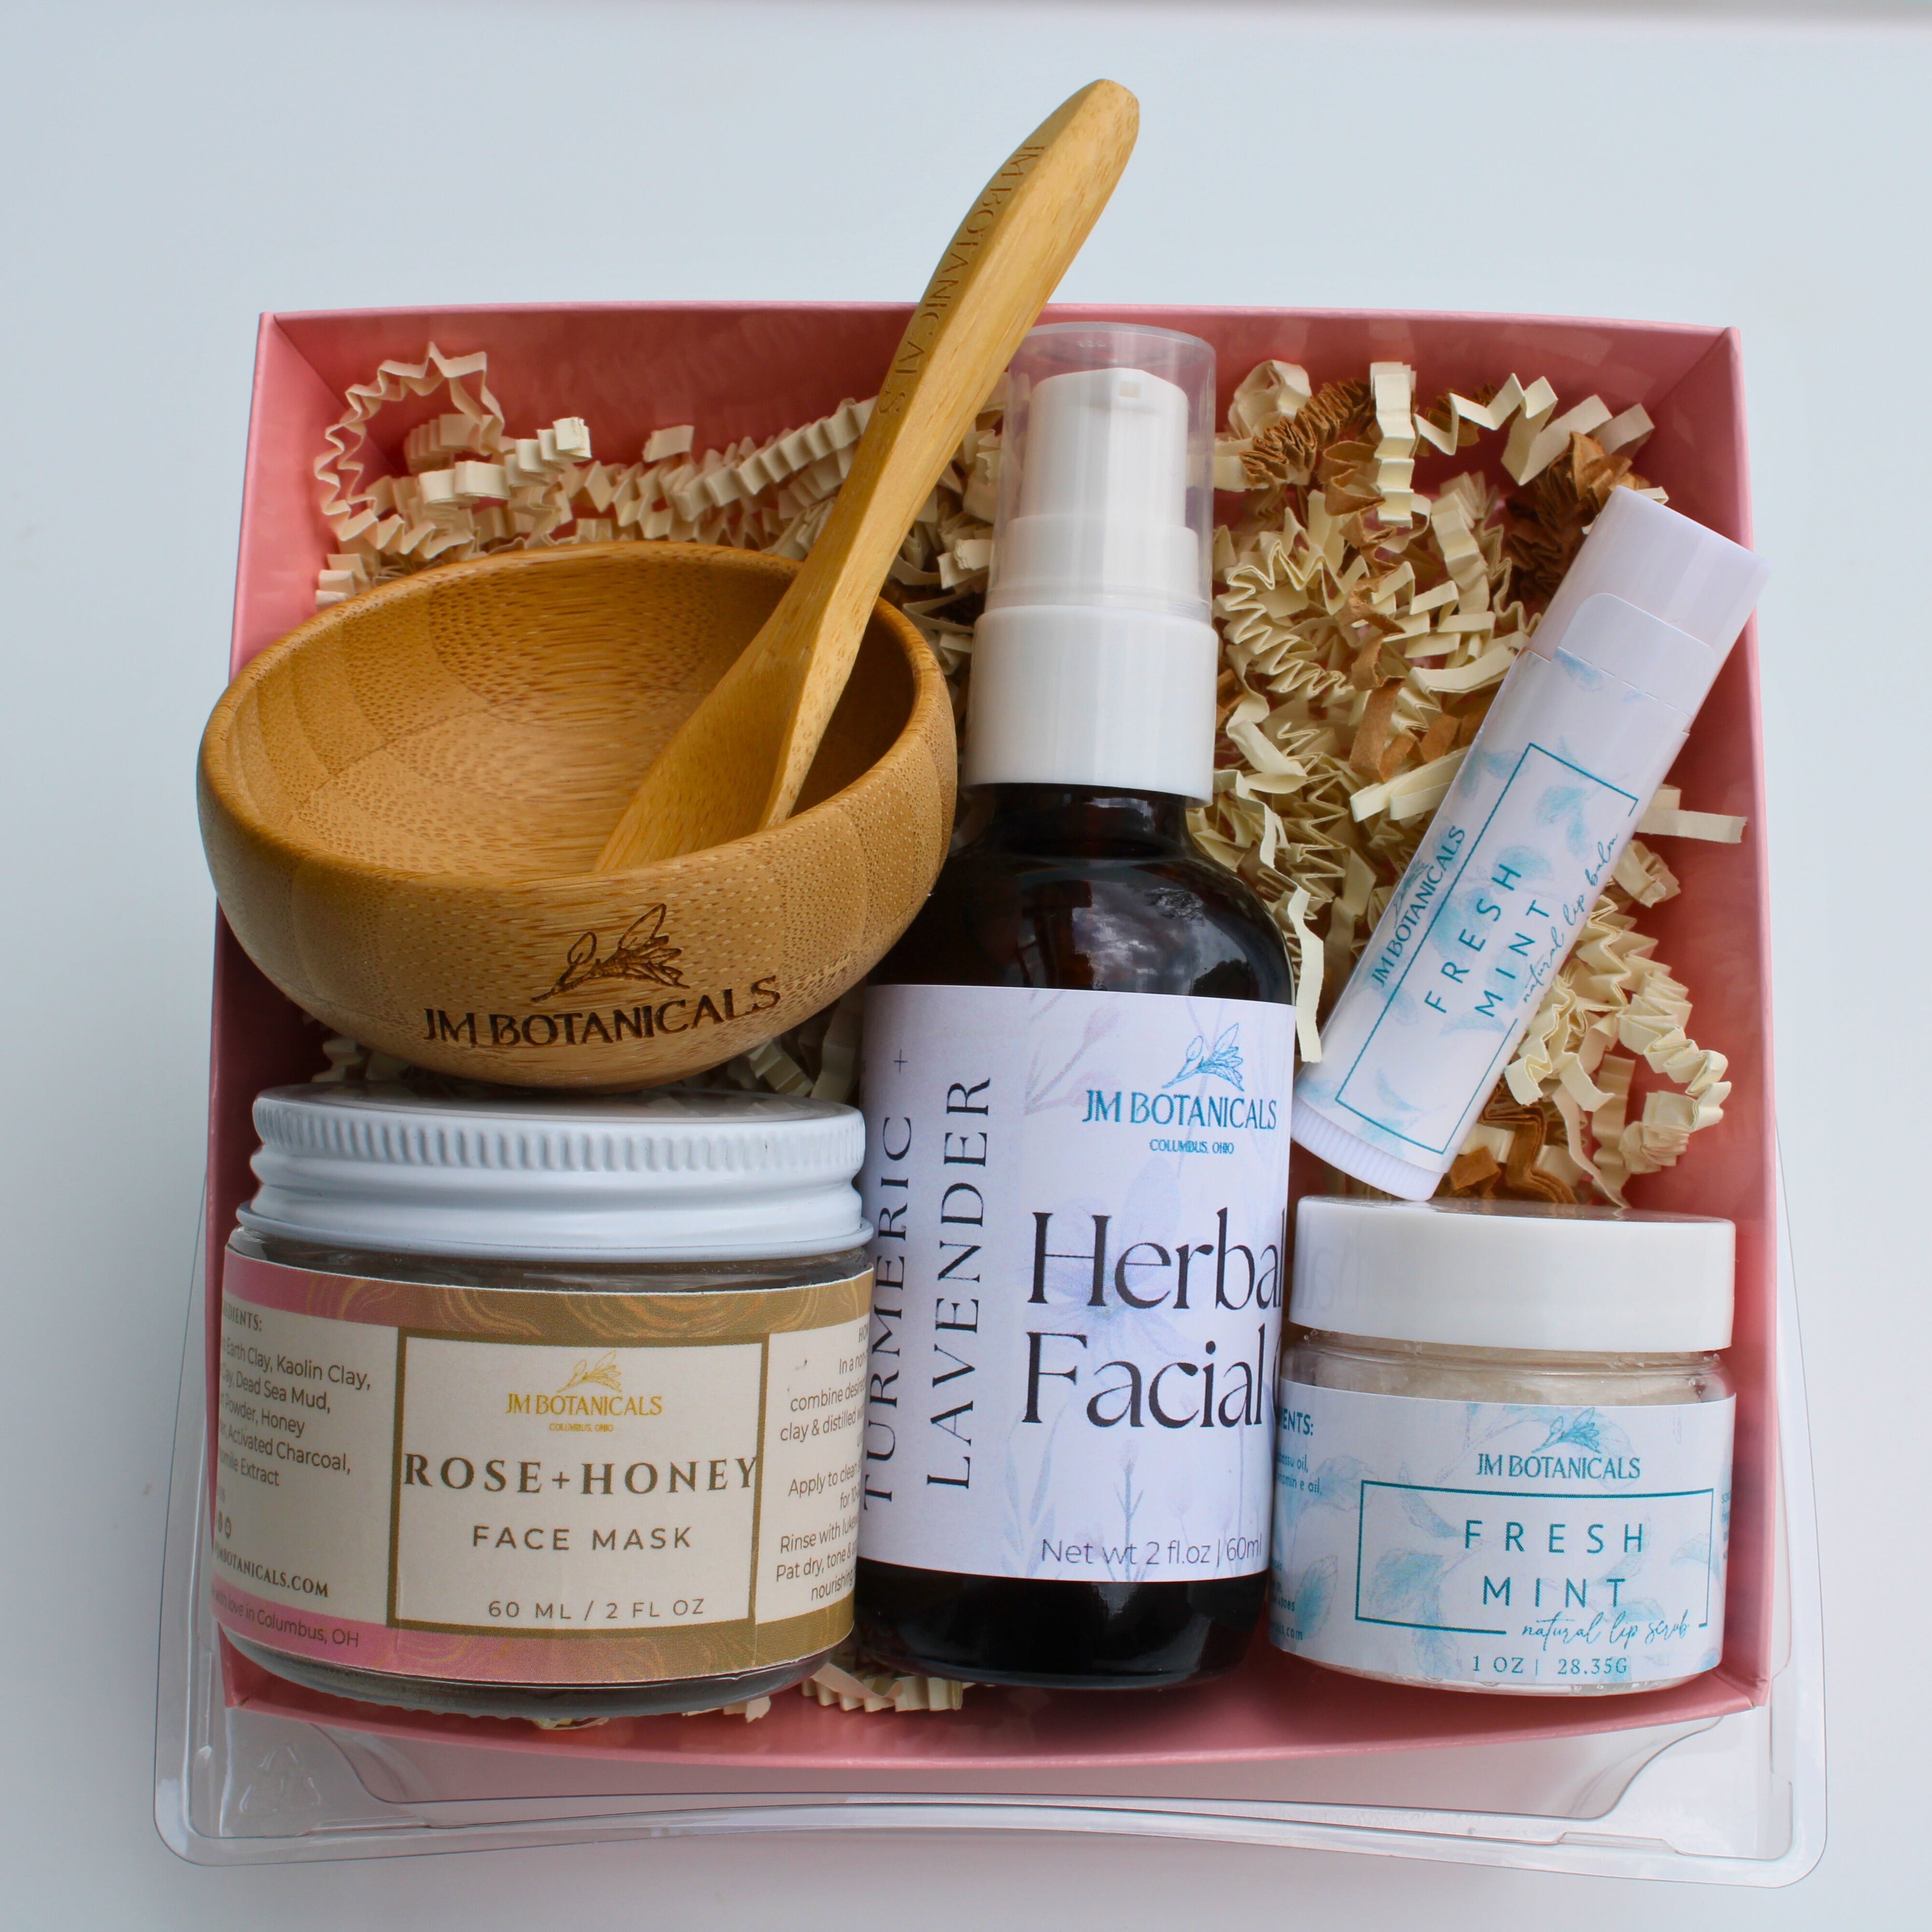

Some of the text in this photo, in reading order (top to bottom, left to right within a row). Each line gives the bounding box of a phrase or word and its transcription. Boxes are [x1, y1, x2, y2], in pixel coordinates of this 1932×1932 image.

[1372, 825, 1466, 988] JM BOTANICALS
[1522, 833, 1619, 1004] natural lip balm
[1423, 863, 1522, 1014] FRESH
[1474, 900, 1550, 1018] MINT
[423, 975, 782, 1047] JM BOTANICALS
[1082, 1089, 1277, 1130] JM BOTANICALS
[1027, 1206, 1285, 1310] Herbal
[927, 1078, 990, 1489] LAVENDER
[863, 1116, 912, 1510] TURMERIC
[248, 1346, 273, 1373] Clay,
[277, 1354, 323, 1381] Kaolin
[328, 1364, 371, 1391] Clay,
[839, 1358, 847, 1375] In
[849, 1359, 854, 1372] a
[1021, 1323, 1266, 1428] Facial
[236, 1371, 261, 1395] Dead
[264, 1380, 287, 1402] Sea
[291, 1387, 330, 1414] Mud,
[506, 1393, 664, 1416] JM BOTANICALS
[790, 1387, 843, 1412] combine
[262, 1407, 306, 1438] Honey
[780, 1422, 809, 1442] clay
[811, 1419, 820, 1435] &
[822, 1406, 856, 1434] distilled
[228, 1424, 273, 1456] Activated
[276, 1441, 351, 1476] Charcoal,
[1297, 1454, 1309, 1473] oil,
[1476, 1453, 1641, 1479] JM BOTANICALS
[240, 1457, 280, 1486] Extract
[788, 1473, 826, 1498] Apply
[828, 1471, 838, 1487] to
[1300, 1480, 1305, 1491] e
[1308, 1477, 1322, 1495] oil,
[841, 1492, 850, 1510] for
[472, 1525, 692, 1551] FACE MASK
[780, 1534, 817, 1553] Rinse
[819, 1521, 841, 1545] with
[1041, 1539, 1093, 1564] Net
[1102, 1541, 1138, 1565] wt
[1146, 1541, 1160, 1565] 2
[1465, 1520, 1643, 1554] FRESH
[776, 1563, 800, 1582] Pat
[803, 1558, 825, 1577] dry,
[827, 1549, 846, 1569] tone
[811, 1568, 853, 1601] nourishing
[1482, 1575, 1626, 1608] MINT
[246, 1603, 255, 1622] in
[257, 1609, 328, 1645] Columbus,
[332, 1628, 359, 1648] OH
[489, 1600, 520, 1618] 60
[535, 1602, 572, 1620] ML
[605, 1603, 618, 1619] 2
[632, 1601, 660, 1618] FL
[673, 1598, 704, 1615] OZ
[1521, 1608, 1690, 1652] natural lip scrub
[1473, 1655, 1480, 1672] 1
[1493, 1656, 1524, 1674] OZ
[1557, 1657, 1627, 1674] 28.35G
